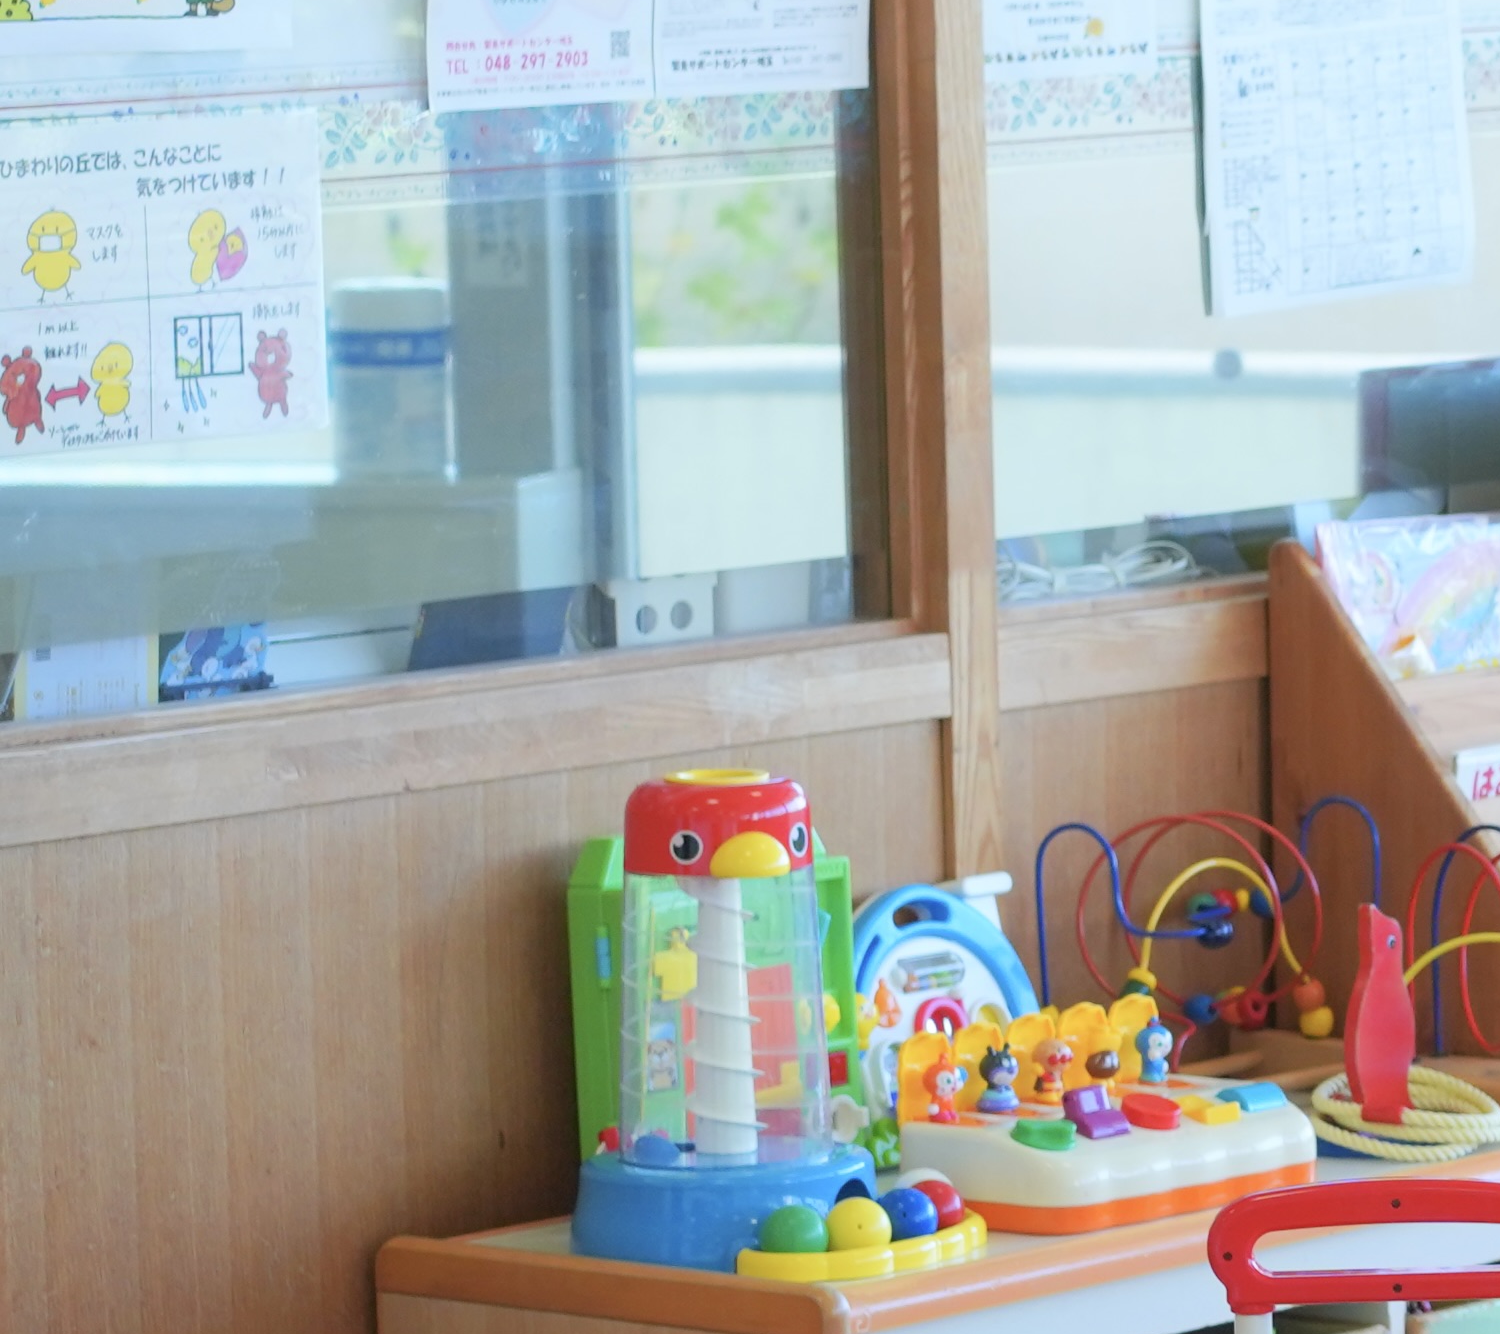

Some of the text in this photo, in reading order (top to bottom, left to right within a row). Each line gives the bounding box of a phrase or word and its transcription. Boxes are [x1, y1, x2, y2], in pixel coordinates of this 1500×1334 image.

[85, 224, 124, 240] マスクを
[92, 246, 119, 263] します
[274, 243, 298, 261] します
